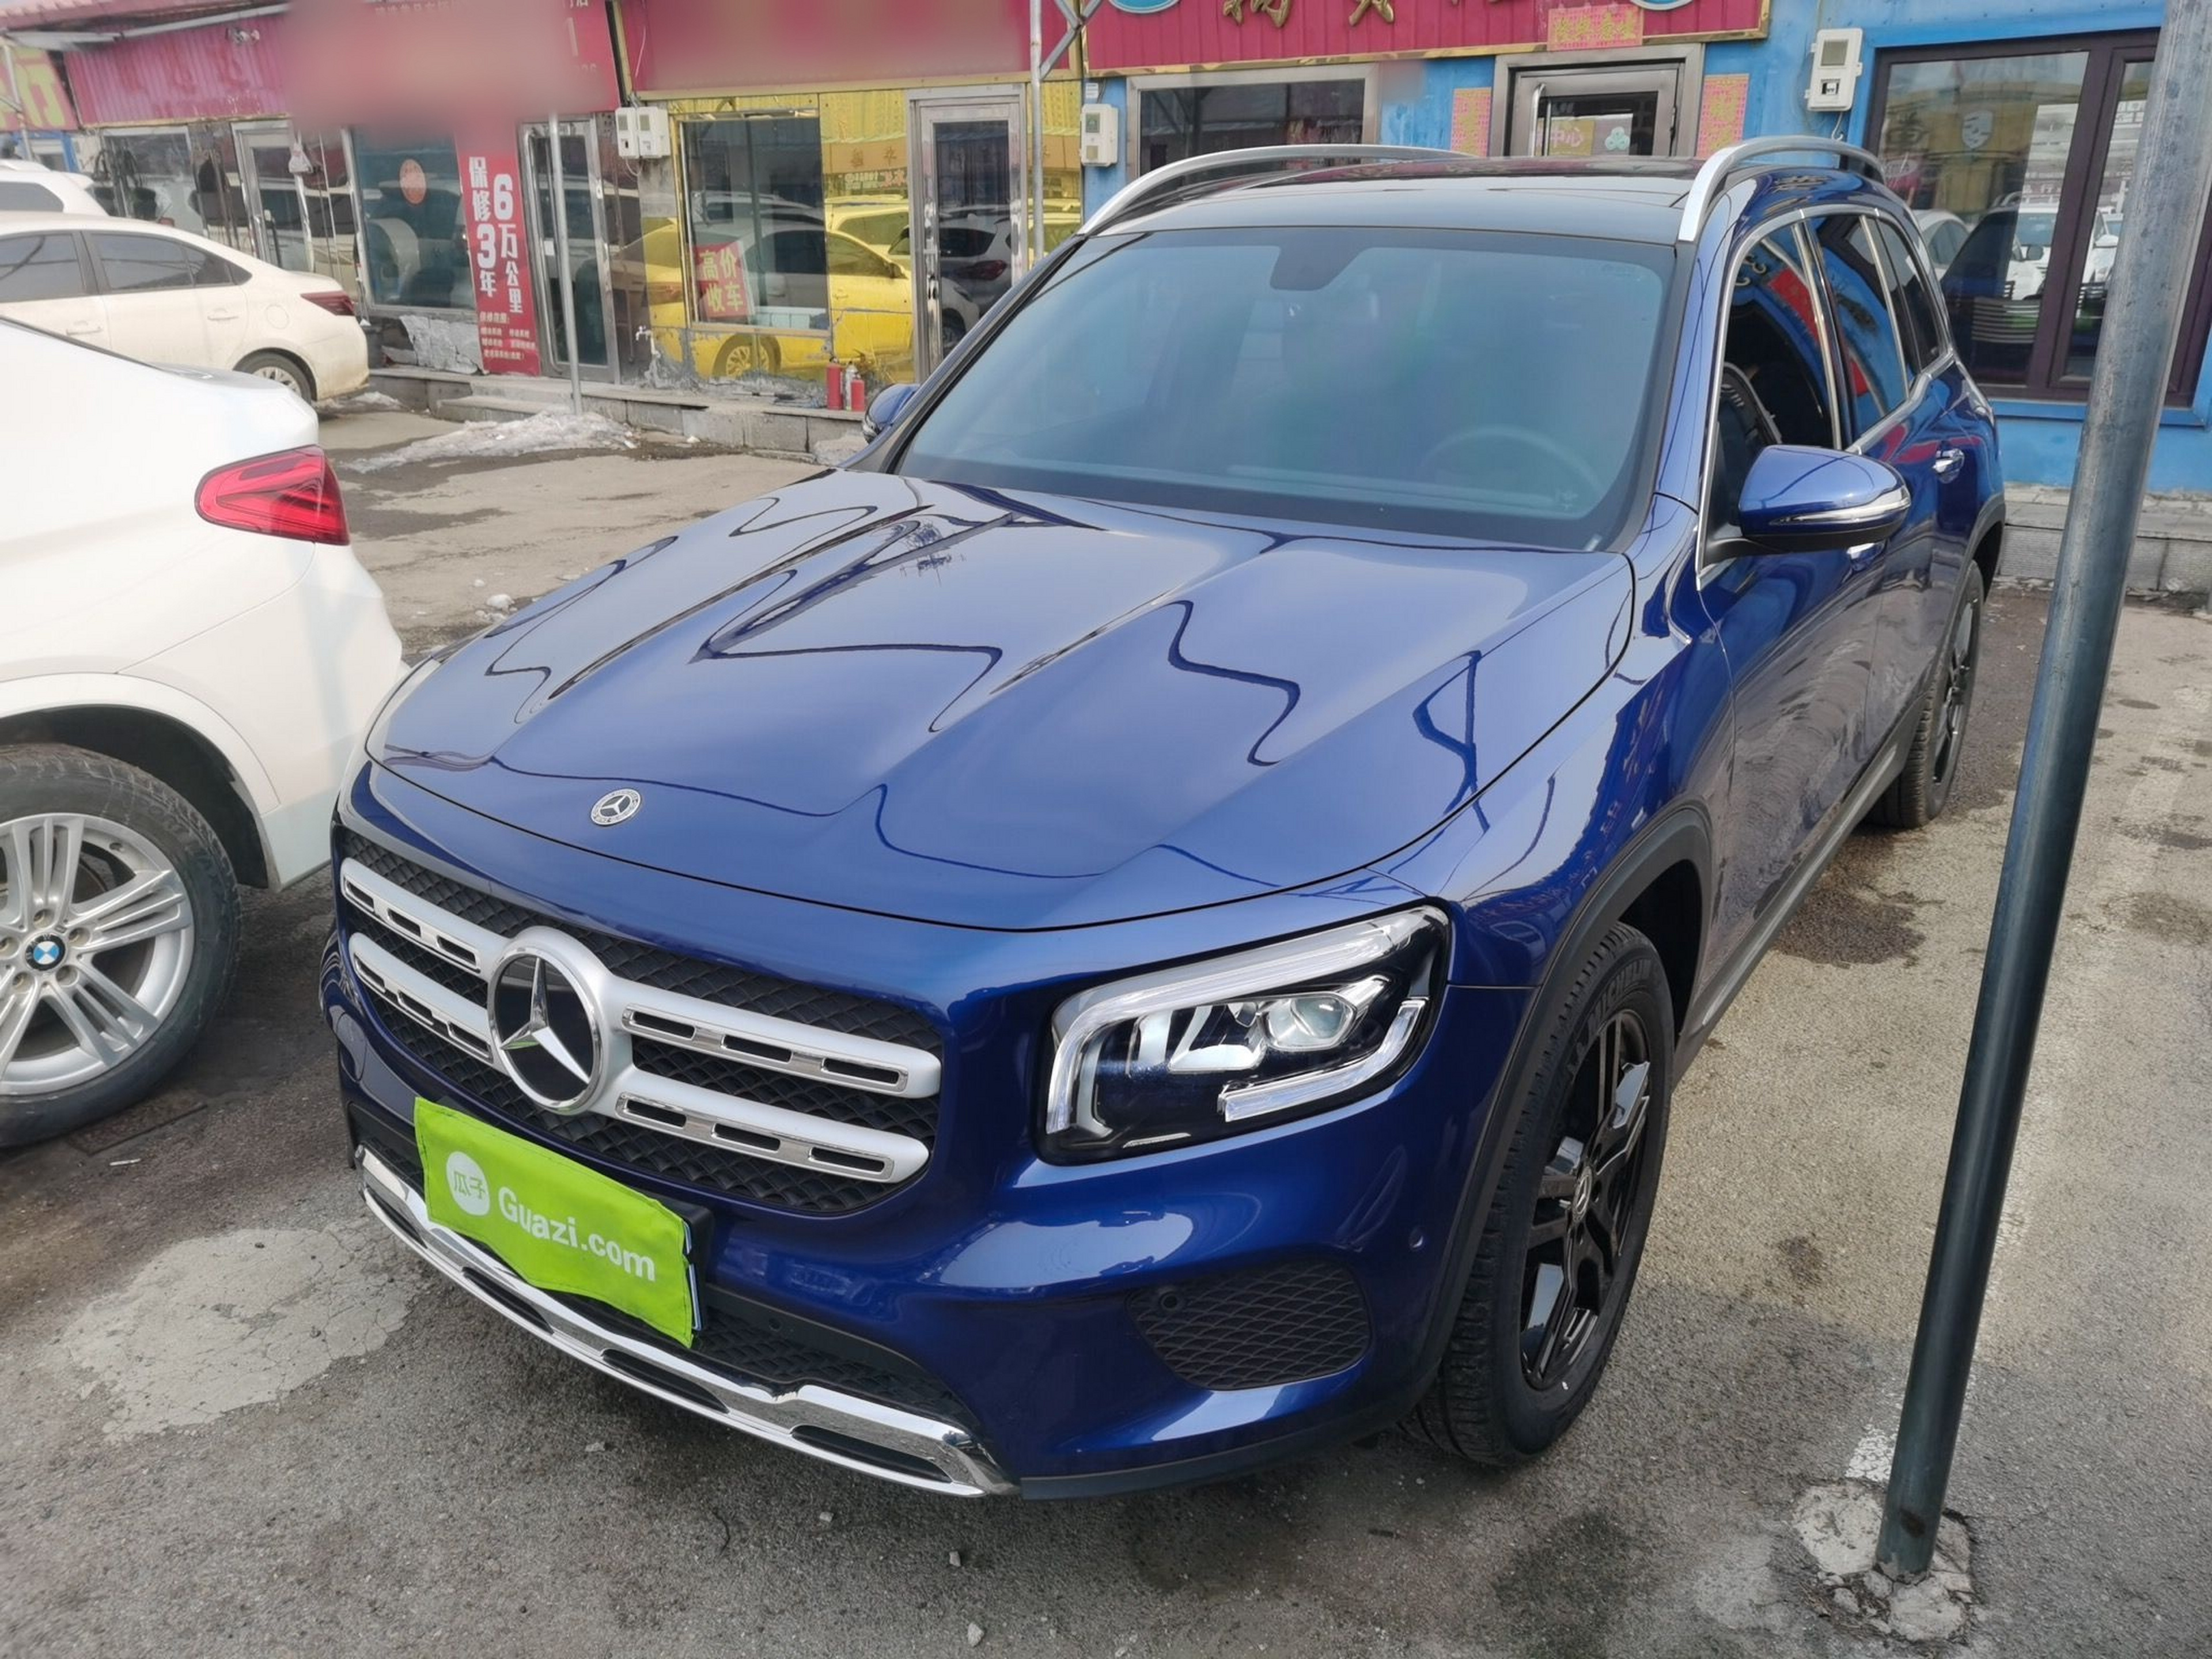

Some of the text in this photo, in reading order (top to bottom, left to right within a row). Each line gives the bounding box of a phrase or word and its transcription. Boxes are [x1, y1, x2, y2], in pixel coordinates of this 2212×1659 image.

[1536, 124, 1584, 149] 中心
[469, 157, 496, 298] 保修3年
[494, 173, 523, 313] 6万公里
[699, 247, 737, 281] 高价
[706, 281, 743, 312] 收车
[453, 1170, 486, 1200] 瓜子
[498, 1186, 656, 1282] Guazi.com
